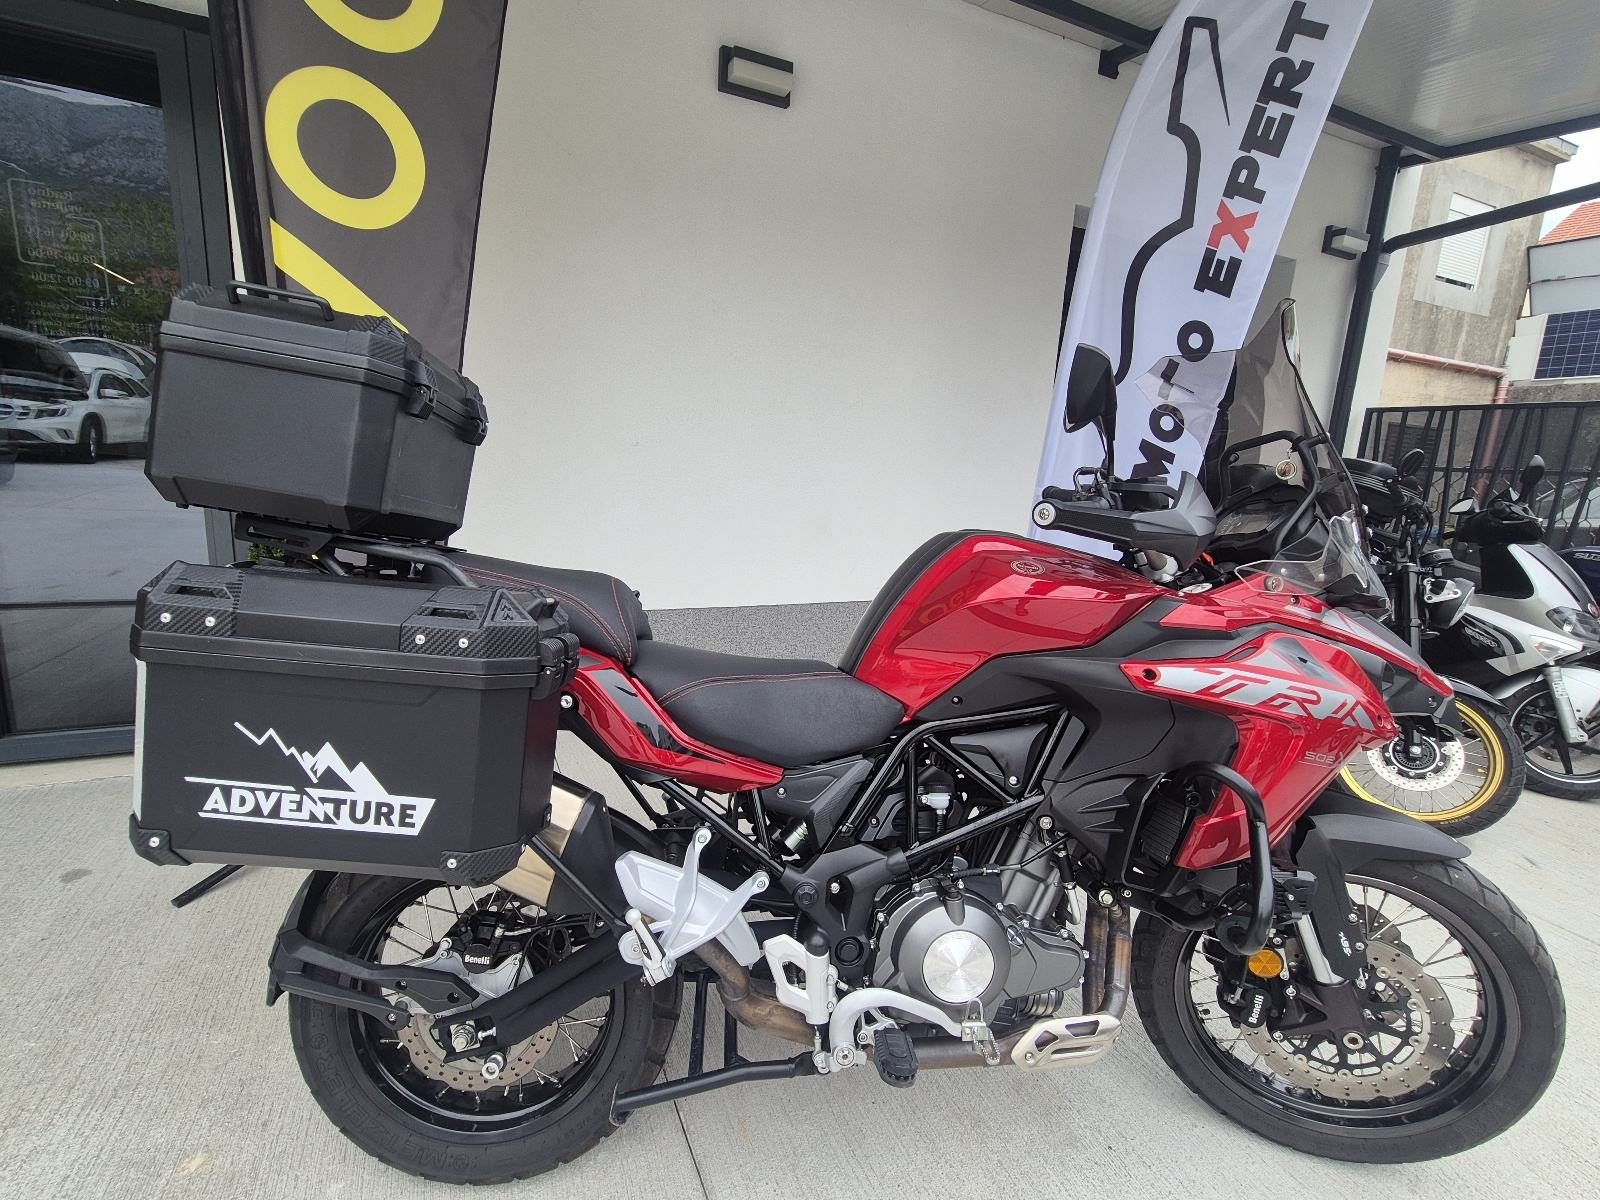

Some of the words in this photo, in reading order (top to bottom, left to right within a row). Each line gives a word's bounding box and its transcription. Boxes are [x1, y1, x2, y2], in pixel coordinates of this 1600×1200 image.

[1193, 0, 1330, 299] EXPERT
[202, 786, 417, 829] ADVENTURE
[464, 954, 491, 966] Benelli
[1247, 994, 1265, 1025] Benelli
